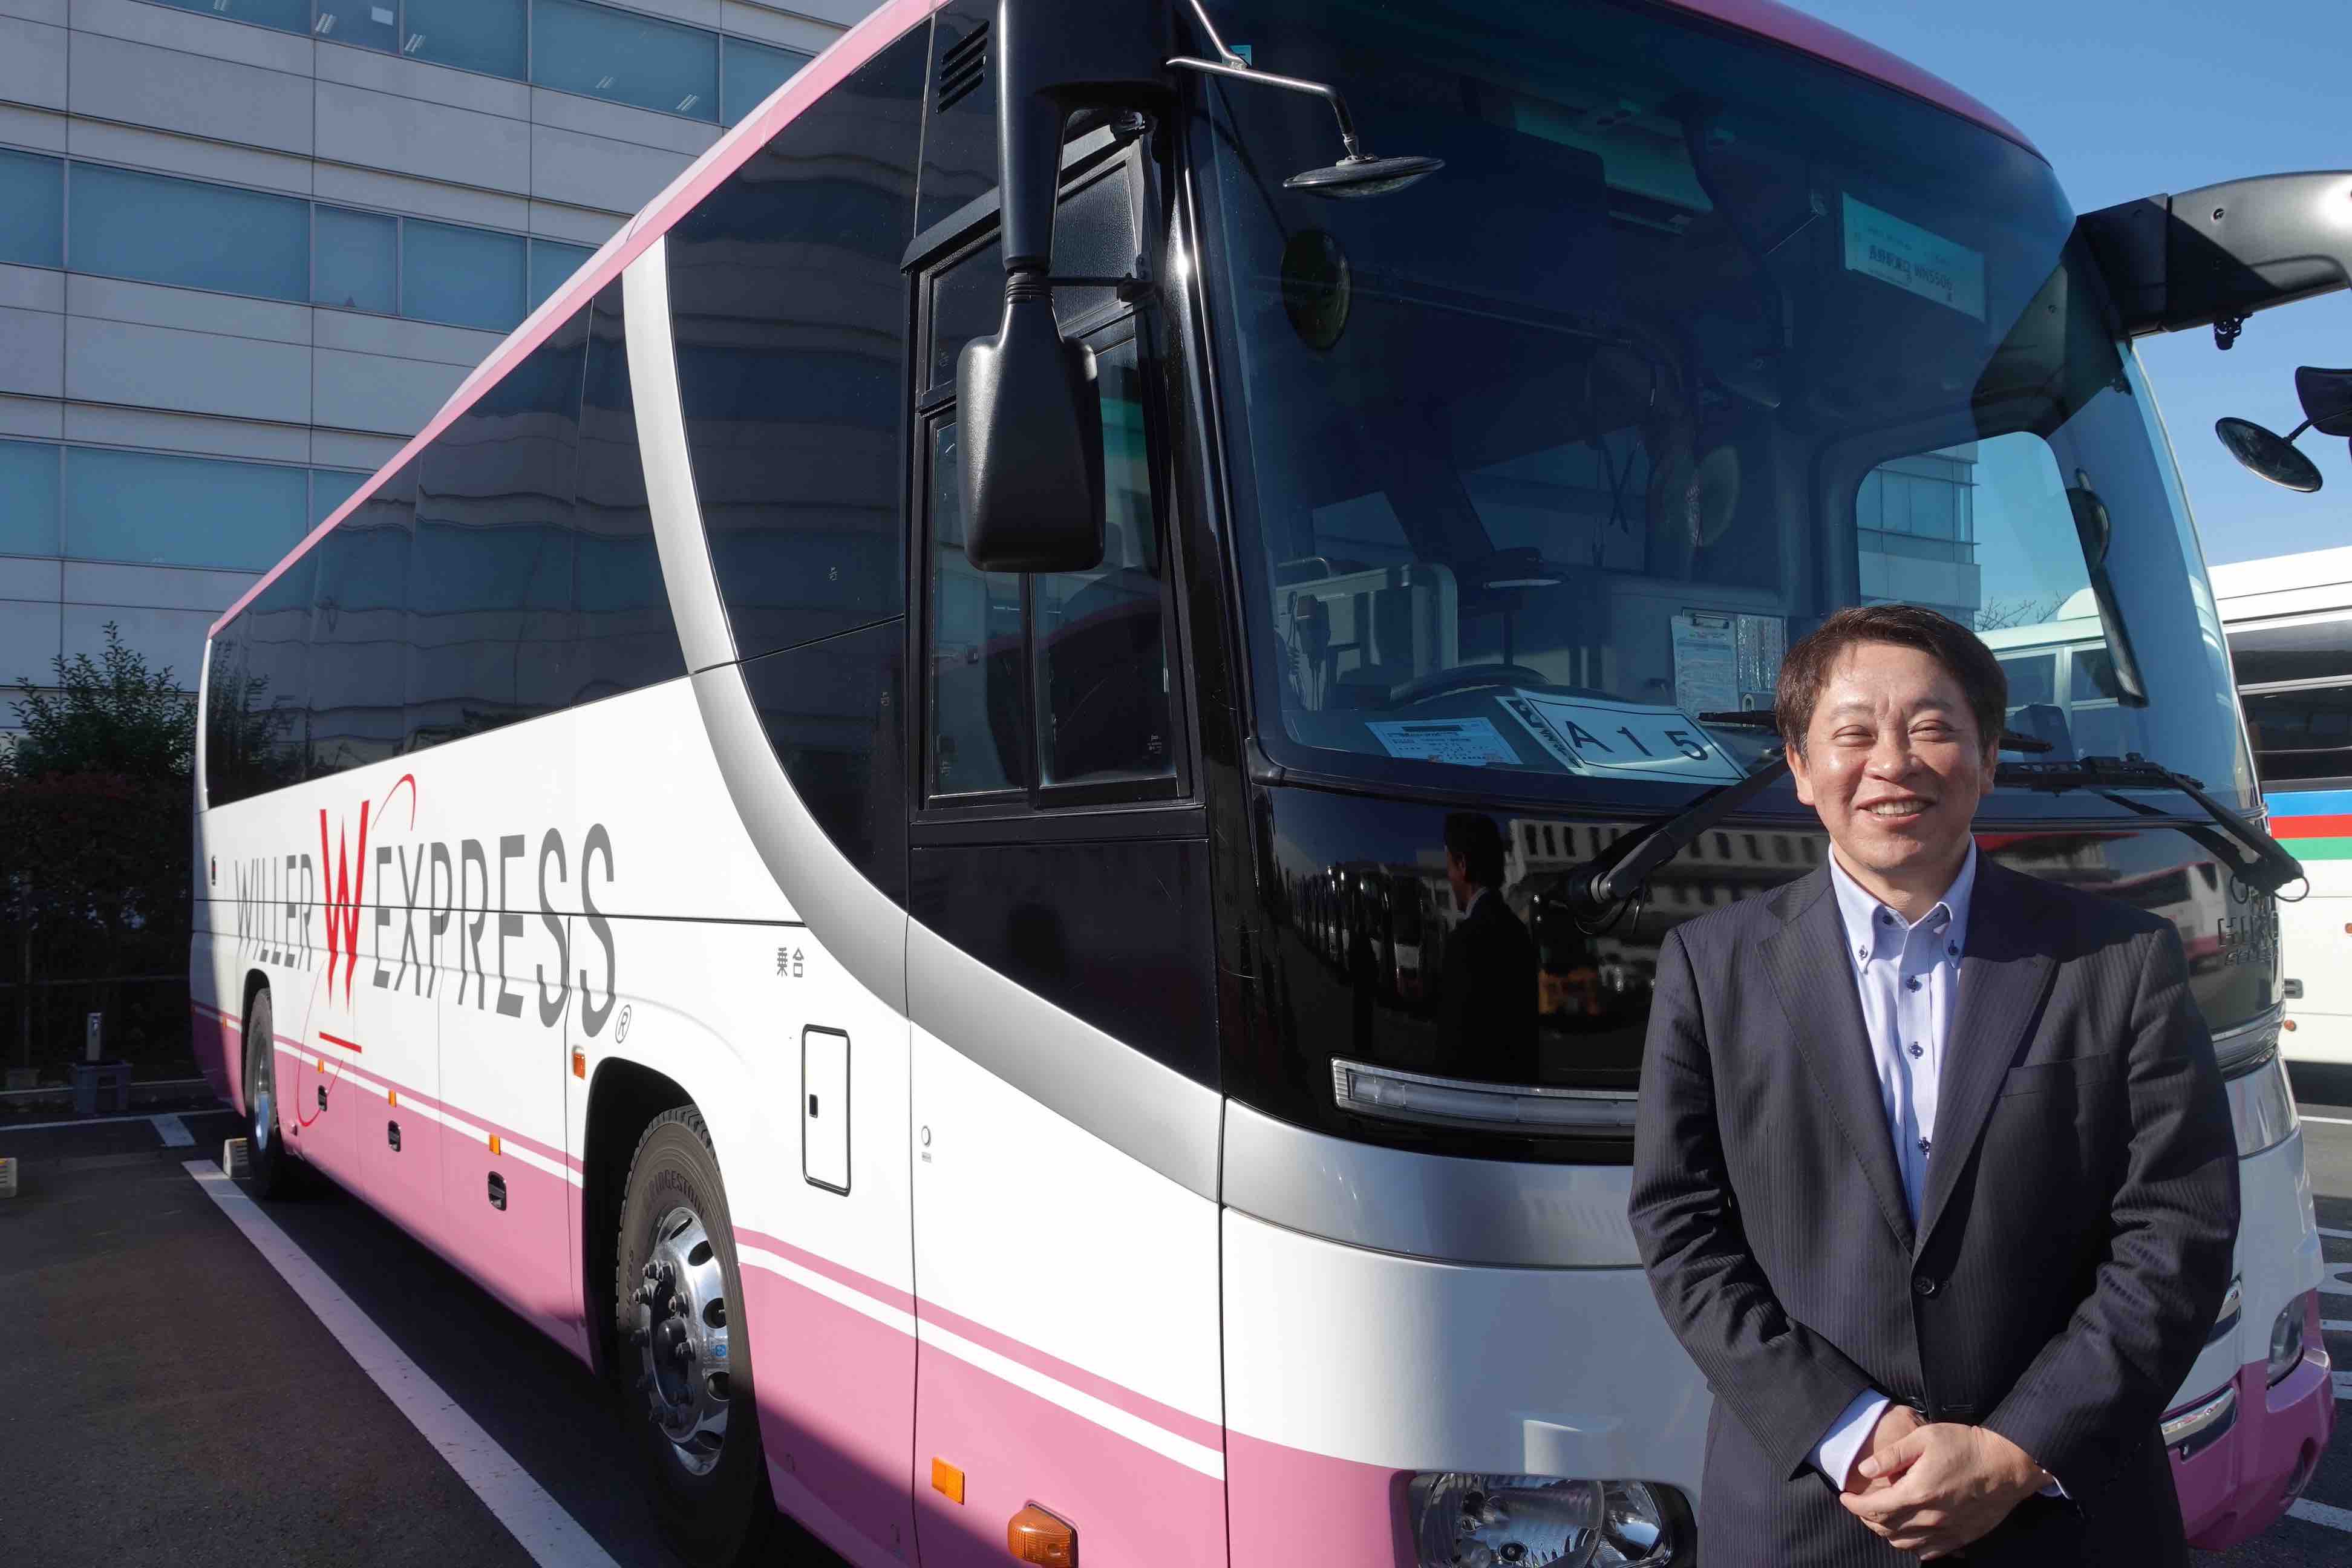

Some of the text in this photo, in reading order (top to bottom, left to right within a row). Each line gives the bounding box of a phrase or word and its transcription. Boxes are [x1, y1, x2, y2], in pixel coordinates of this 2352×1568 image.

[235, 853, 313, 972] WILLER
[373, 823, 616, 1037] EXPRESS
[777, 947, 804, 978] 乗合
